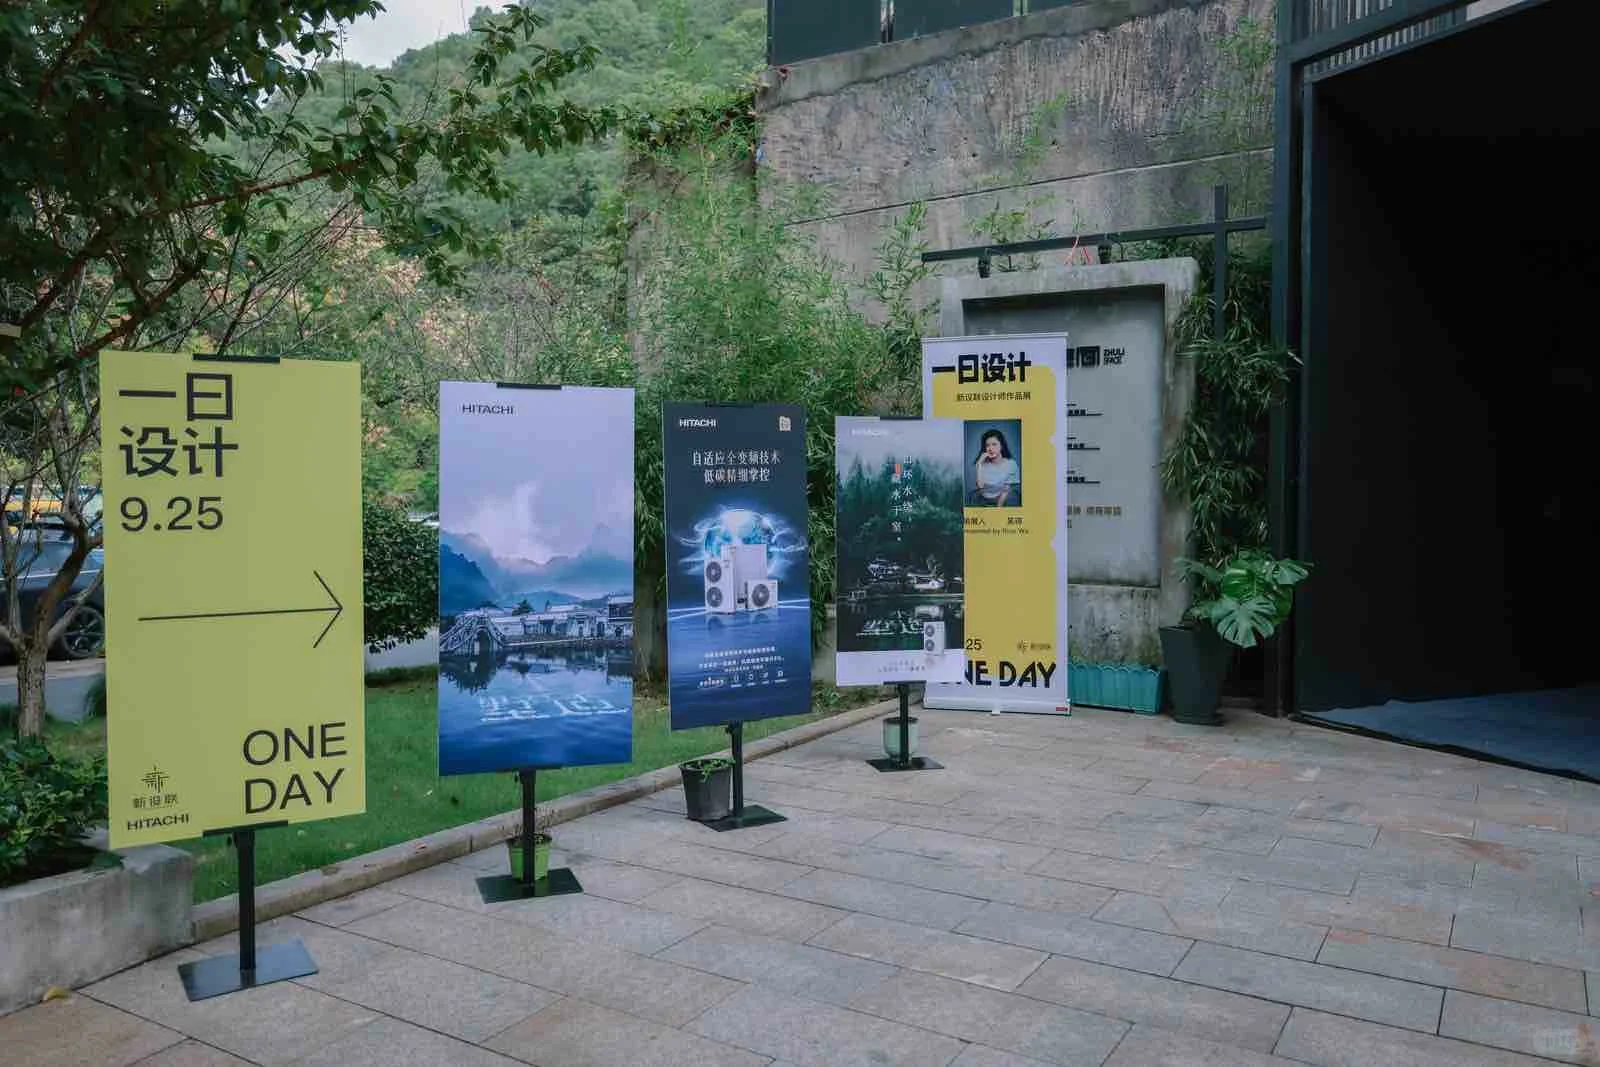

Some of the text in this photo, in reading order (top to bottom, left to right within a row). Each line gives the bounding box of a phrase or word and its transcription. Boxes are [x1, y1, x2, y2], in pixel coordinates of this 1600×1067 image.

[931, 351, 1032, 385] 一日设计
[118, 372, 233, 421] 一日
[462, 403, 514, 415] HITACHI
[679, 418, 717, 427] HITACHI
[119, 426, 239, 477] 设计
[120, 496, 223, 532] 9.25
[999, 661, 1056, 688] DAY
[243, 721, 347, 766] ONE
[245, 768, 345, 814] DAY
[127, 813, 189, 831] HITACHI
